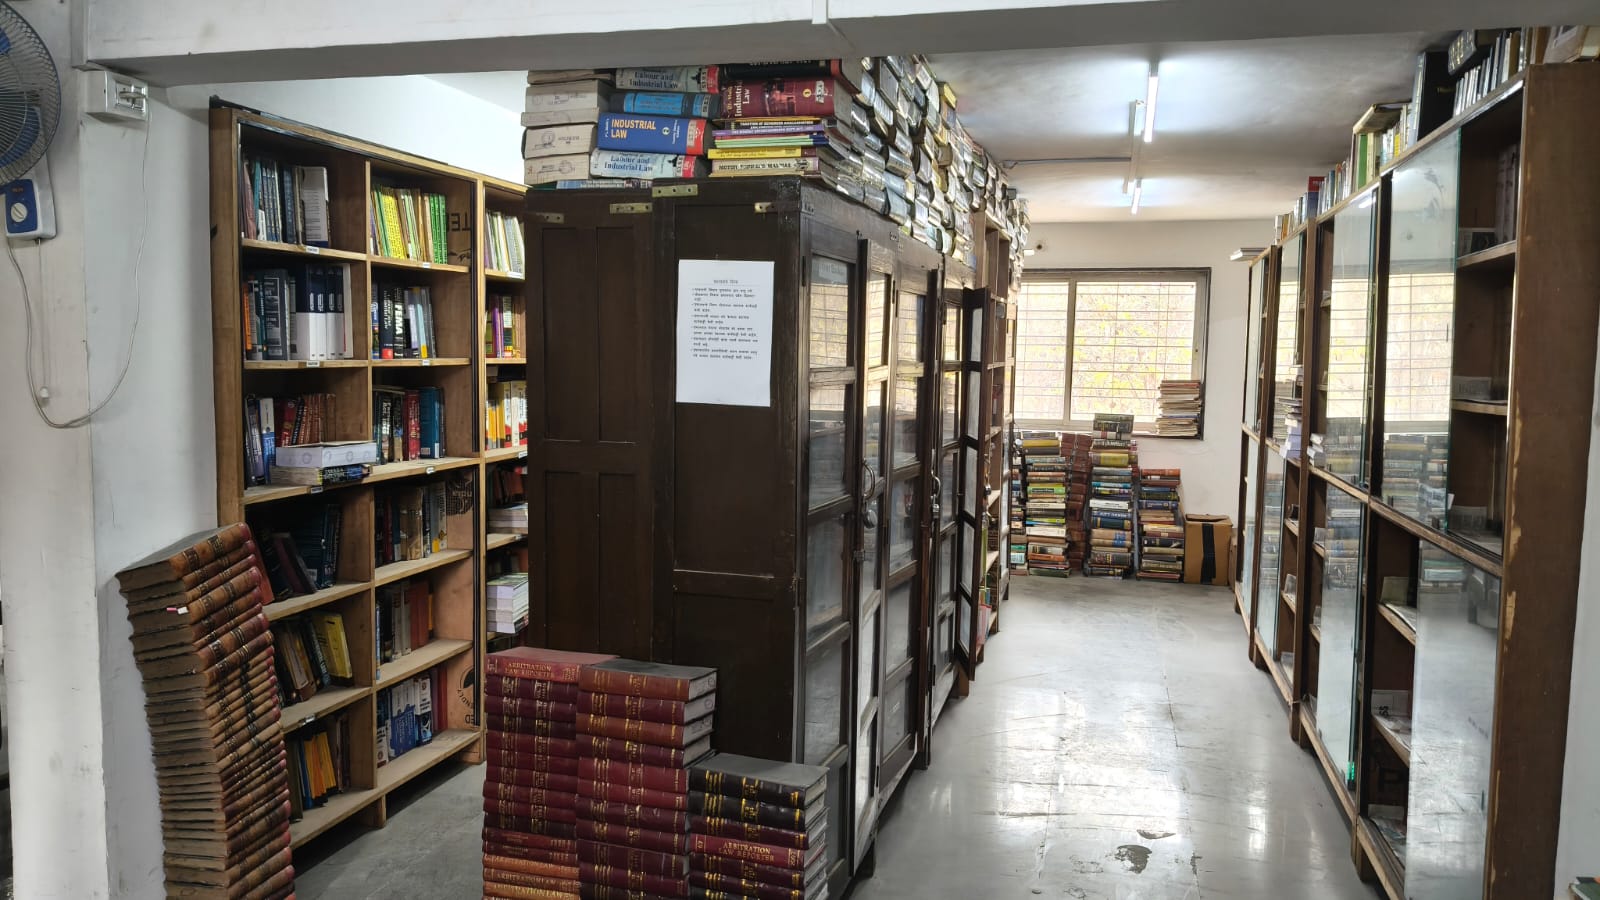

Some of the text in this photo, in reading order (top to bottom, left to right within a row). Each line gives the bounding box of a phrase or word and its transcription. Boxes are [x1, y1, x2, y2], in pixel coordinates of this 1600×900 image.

[742, 88, 750, 104] Law
[611, 118, 657, 130] INDUSTRIAL
[610, 129, 627, 139] LAW
[394, 303, 403, 335] FEMA
[508, 662, 552, 671] ARBITRATION
[723, 842, 771, 854] ARBITRATION
[719, 848, 775, 862] LAW REPORTER
